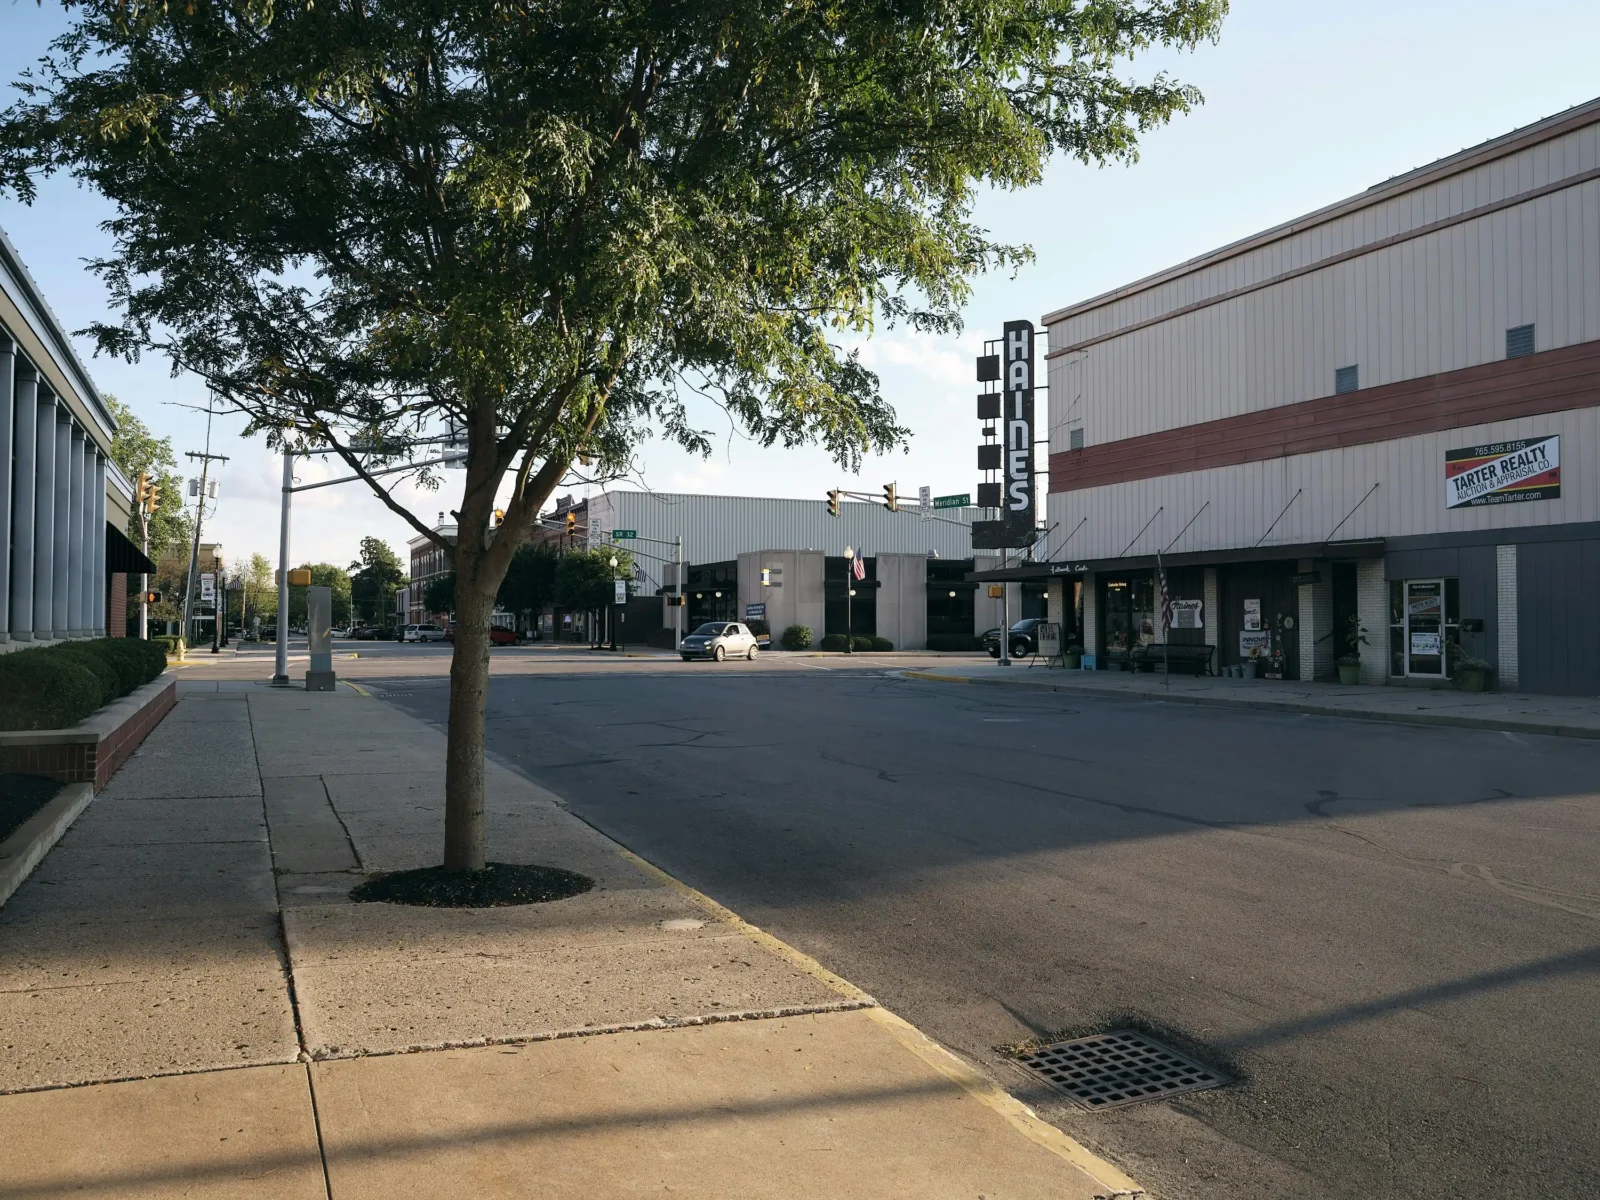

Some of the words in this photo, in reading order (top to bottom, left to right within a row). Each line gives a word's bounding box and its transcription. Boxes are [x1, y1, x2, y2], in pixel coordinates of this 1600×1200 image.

[1008, 329, 1029, 511] HAINES
[1474, 441, 1526, 456] 765.595.8155
[1452, 464, 1498, 492] TARTER
[1499, 444, 1546, 474] REALTY
[1457, 481, 1488, 501] AUCTION
[1489, 477, 1496, 489] &
[1496, 466, 1537, 486] APPRAISAL
[1538, 458, 1553, 471] CO.
[934, 498, 960, 507] Meridian
[962, 496, 969, 504] St
[1470, 491, 1542, 505] www.TeamTarter.com
